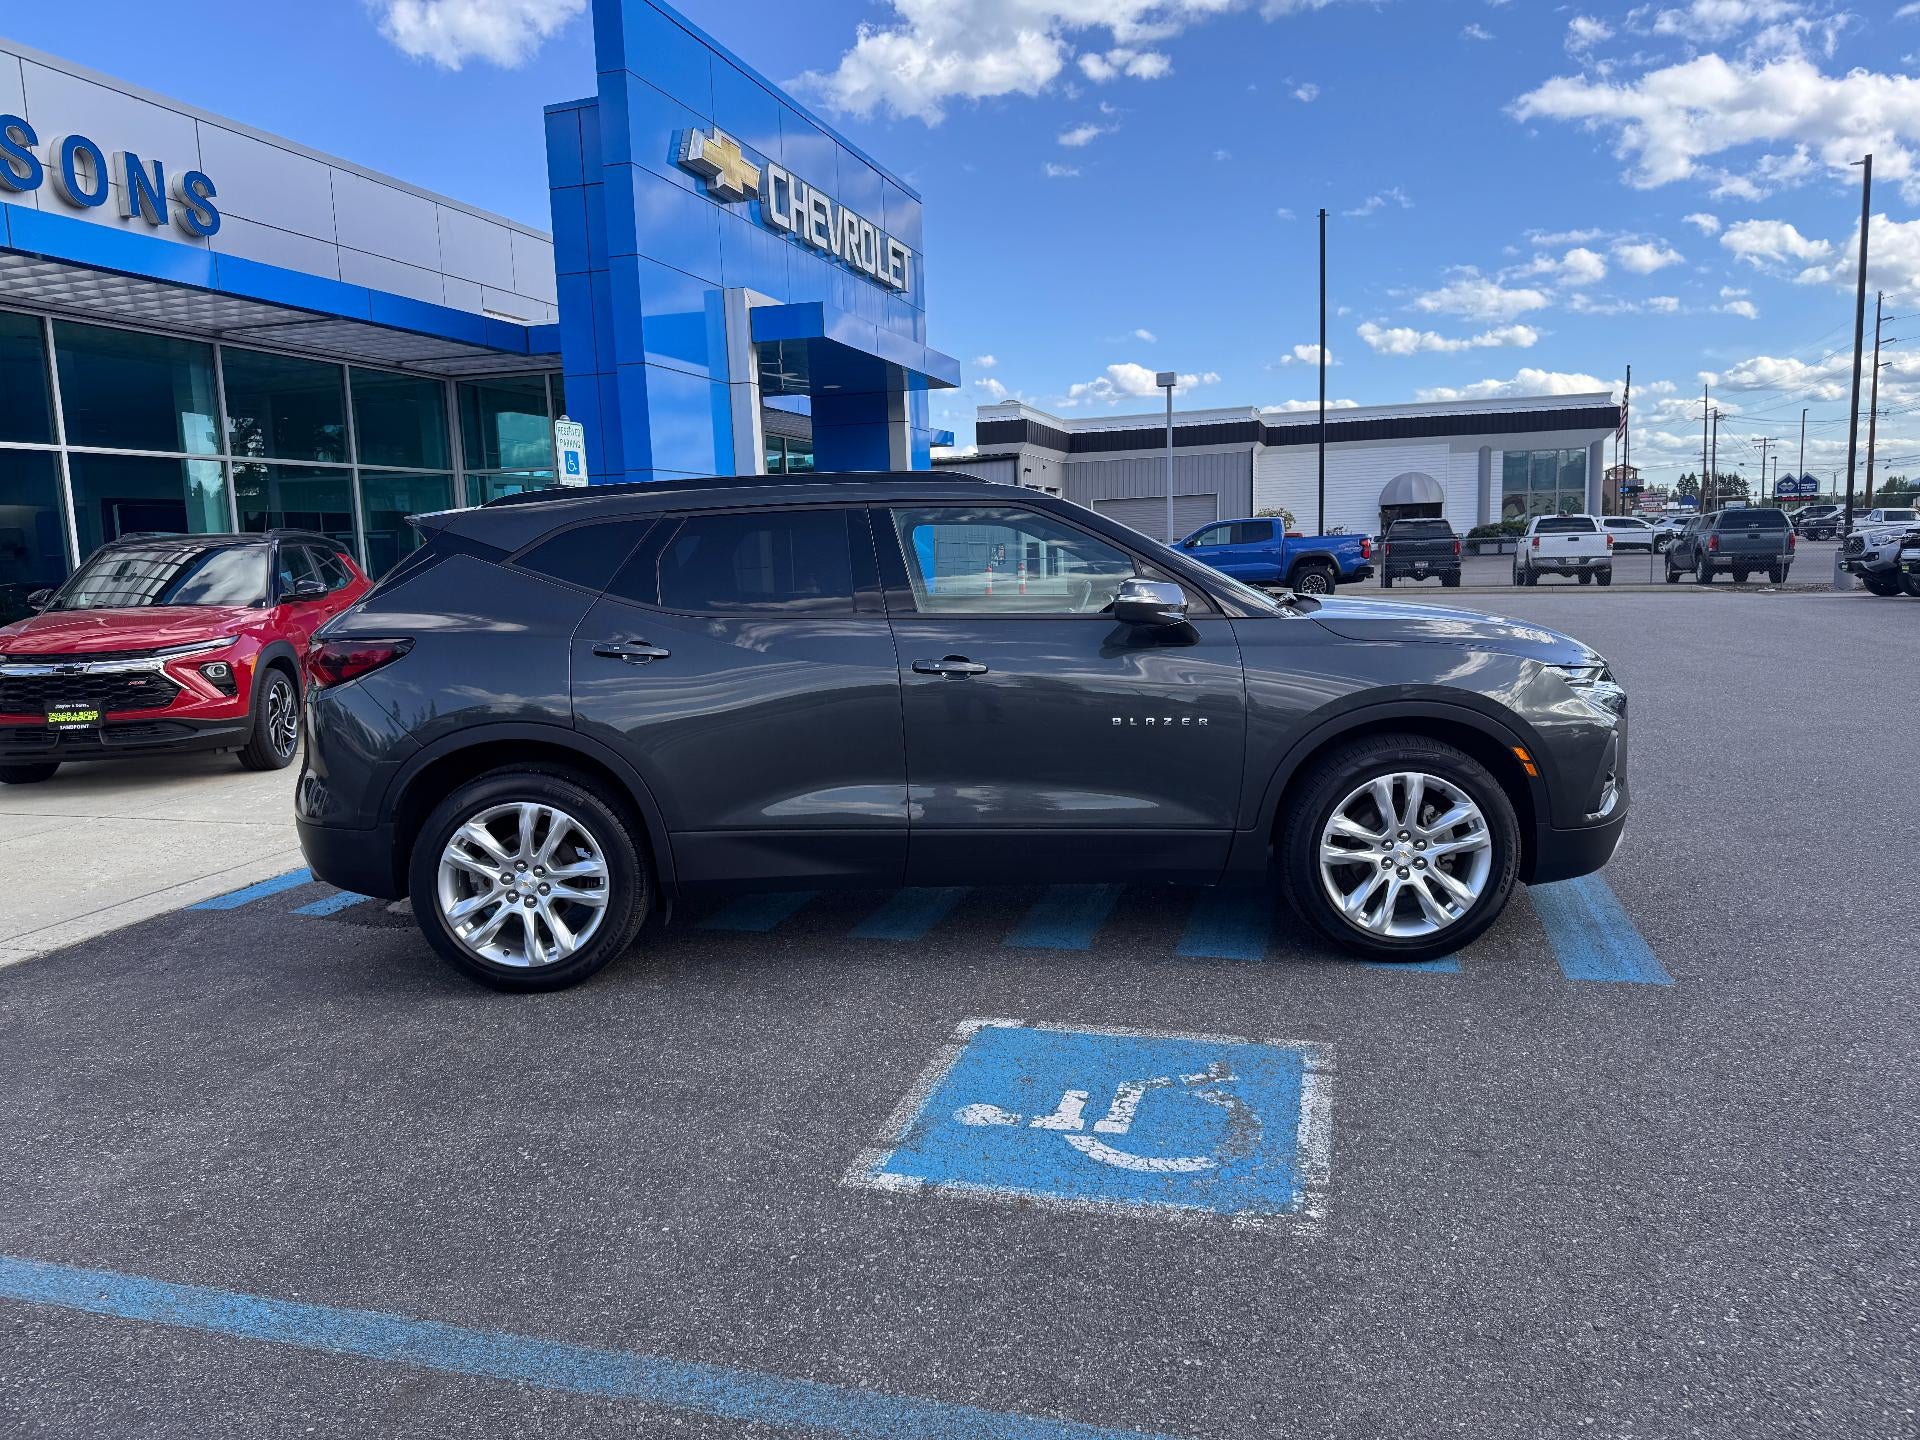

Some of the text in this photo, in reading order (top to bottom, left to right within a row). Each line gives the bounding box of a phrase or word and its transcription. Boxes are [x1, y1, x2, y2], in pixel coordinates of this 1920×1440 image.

[0, 114, 221, 237] SONS
[764, 161, 912, 293] CHEVROLET
[1112, 717, 1208, 726] BLAZER
